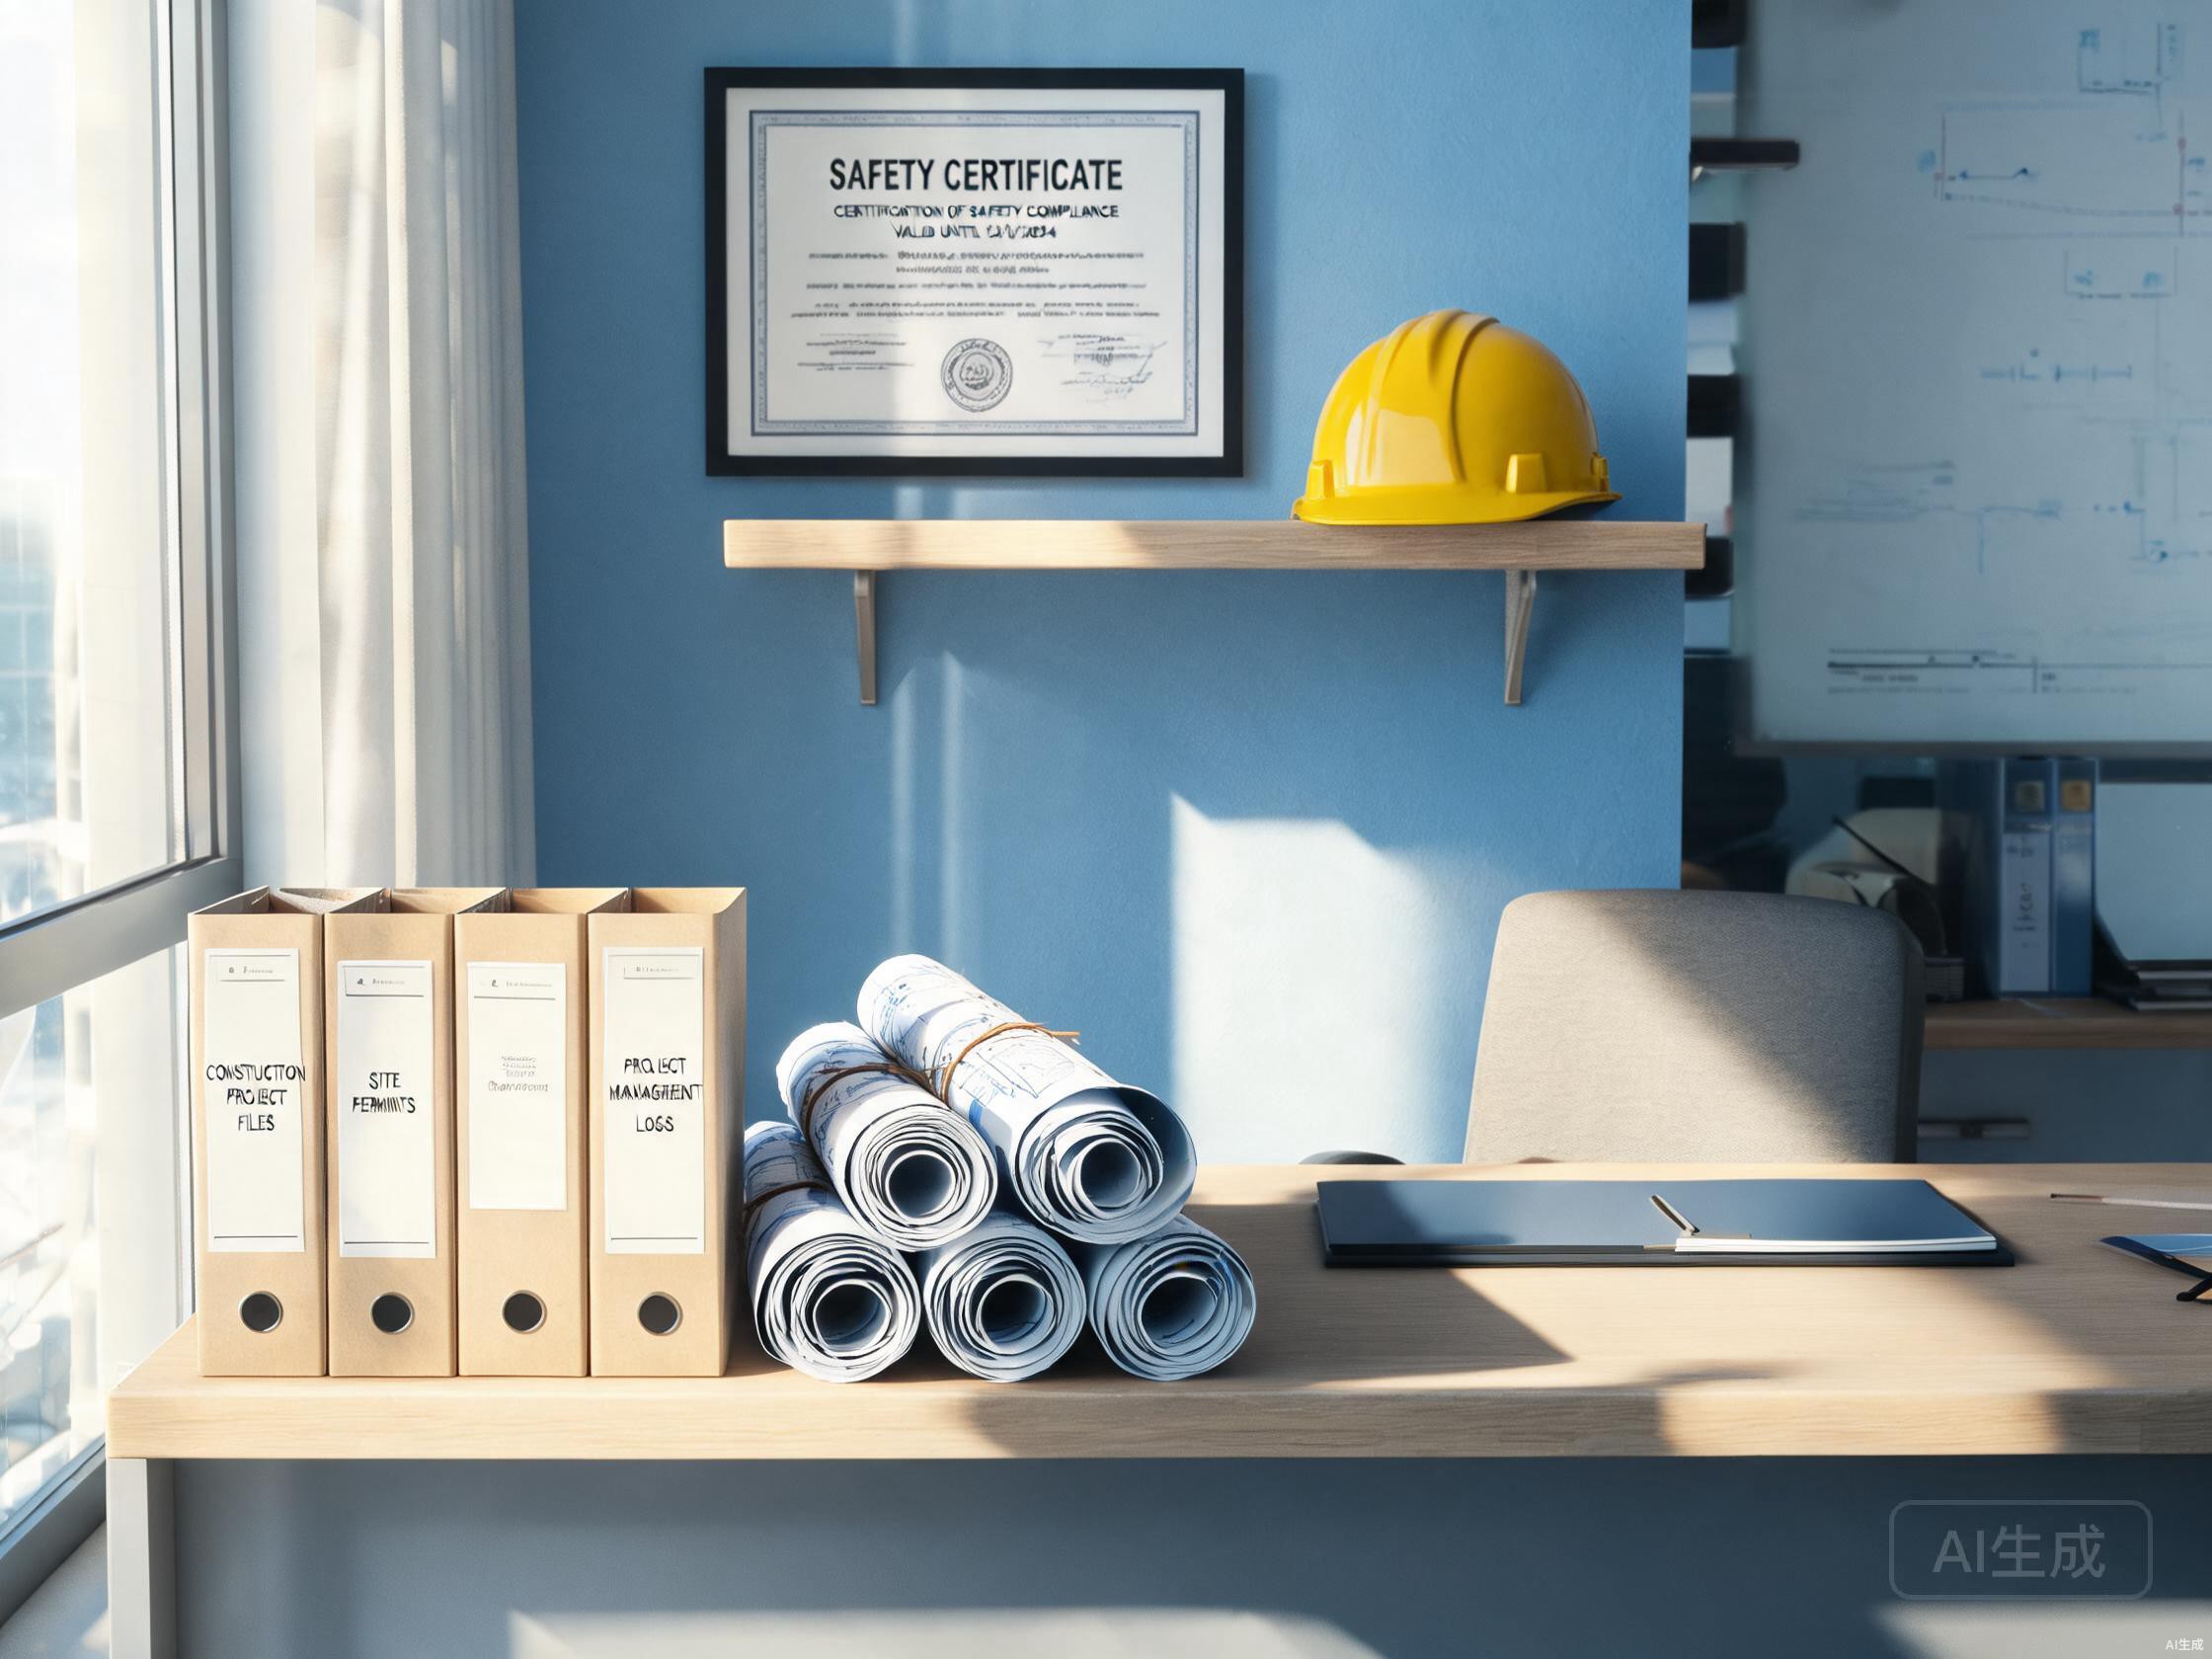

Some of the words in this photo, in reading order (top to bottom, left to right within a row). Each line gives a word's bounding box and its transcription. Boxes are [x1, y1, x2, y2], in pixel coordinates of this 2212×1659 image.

[830, 158, 934, 191] SAFETY
[944, 158, 1123, 192] CERTIFICATE
[948, 204, 966, 218] OF
[969, 204, 1022, 217] SAFETY
[368, 1071, 401, 1090] SITE
[238, 1113, 275, 1132] FILES
